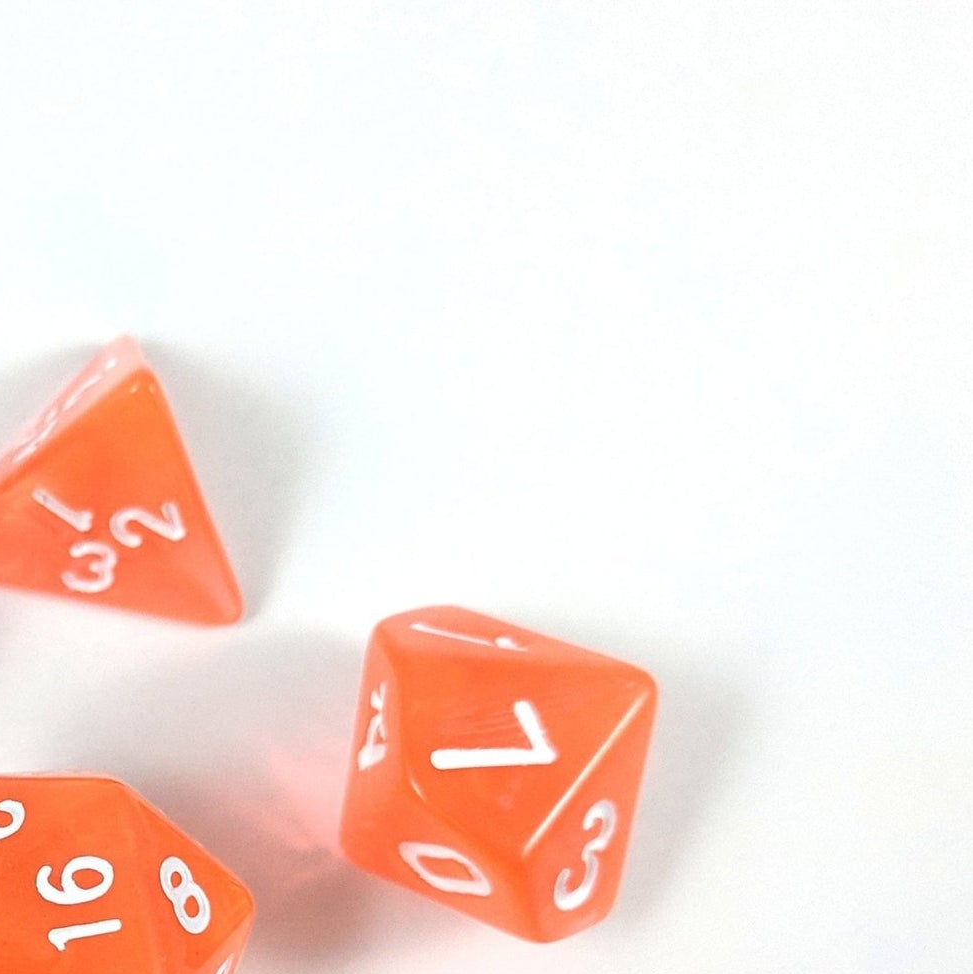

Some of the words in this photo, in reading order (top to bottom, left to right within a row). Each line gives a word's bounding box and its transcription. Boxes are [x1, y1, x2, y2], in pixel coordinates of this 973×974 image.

[108, 502, 186, 549] 2
[60, 541, 118, 594] 3
[399, 842, 493, 897] 0
[553, 799, 616, 911] 3
[35, 855, 123, 952] 16
[159, 855, 211, 935] 8
